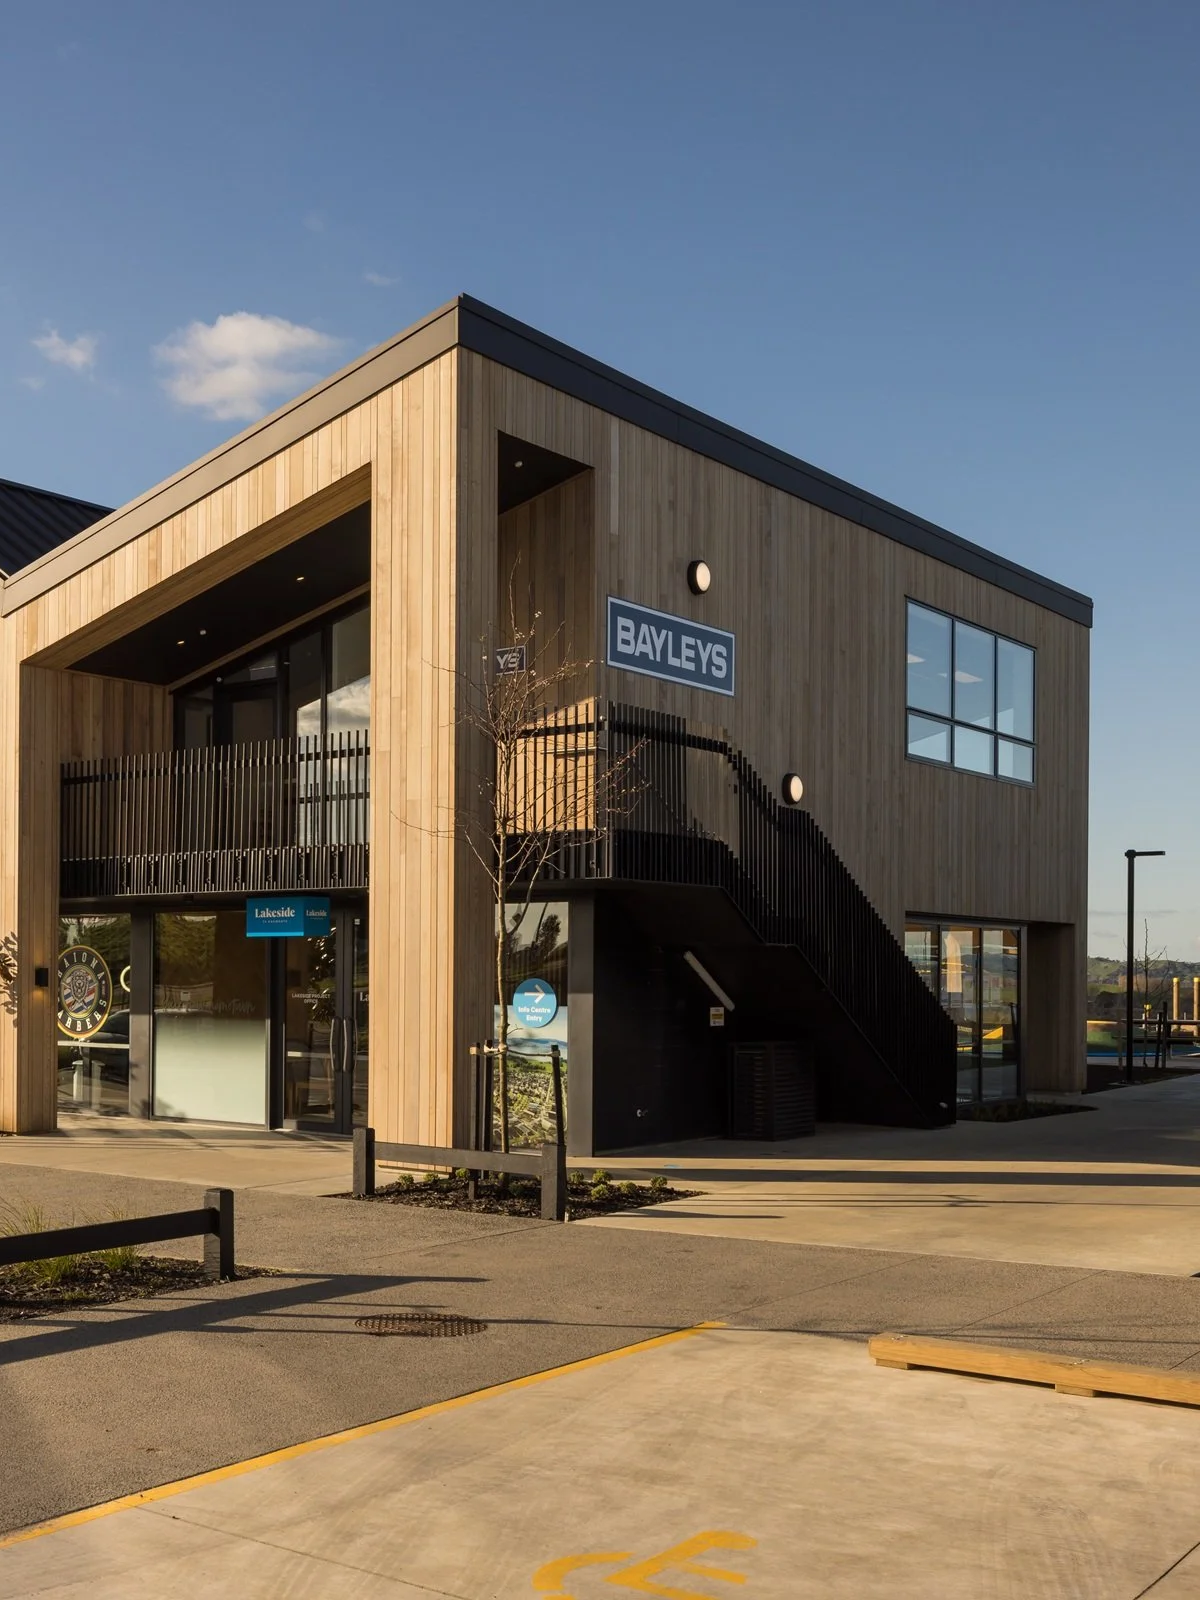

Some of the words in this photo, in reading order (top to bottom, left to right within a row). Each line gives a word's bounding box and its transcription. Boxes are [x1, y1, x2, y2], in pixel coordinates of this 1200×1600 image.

[617, 616, 728, 679] BAYLEYS
[255, 906, 296, 918] Lakeside
[57, 997, 107, 1032] ARBERS
[526, 1014, 543, 1022] Entry
